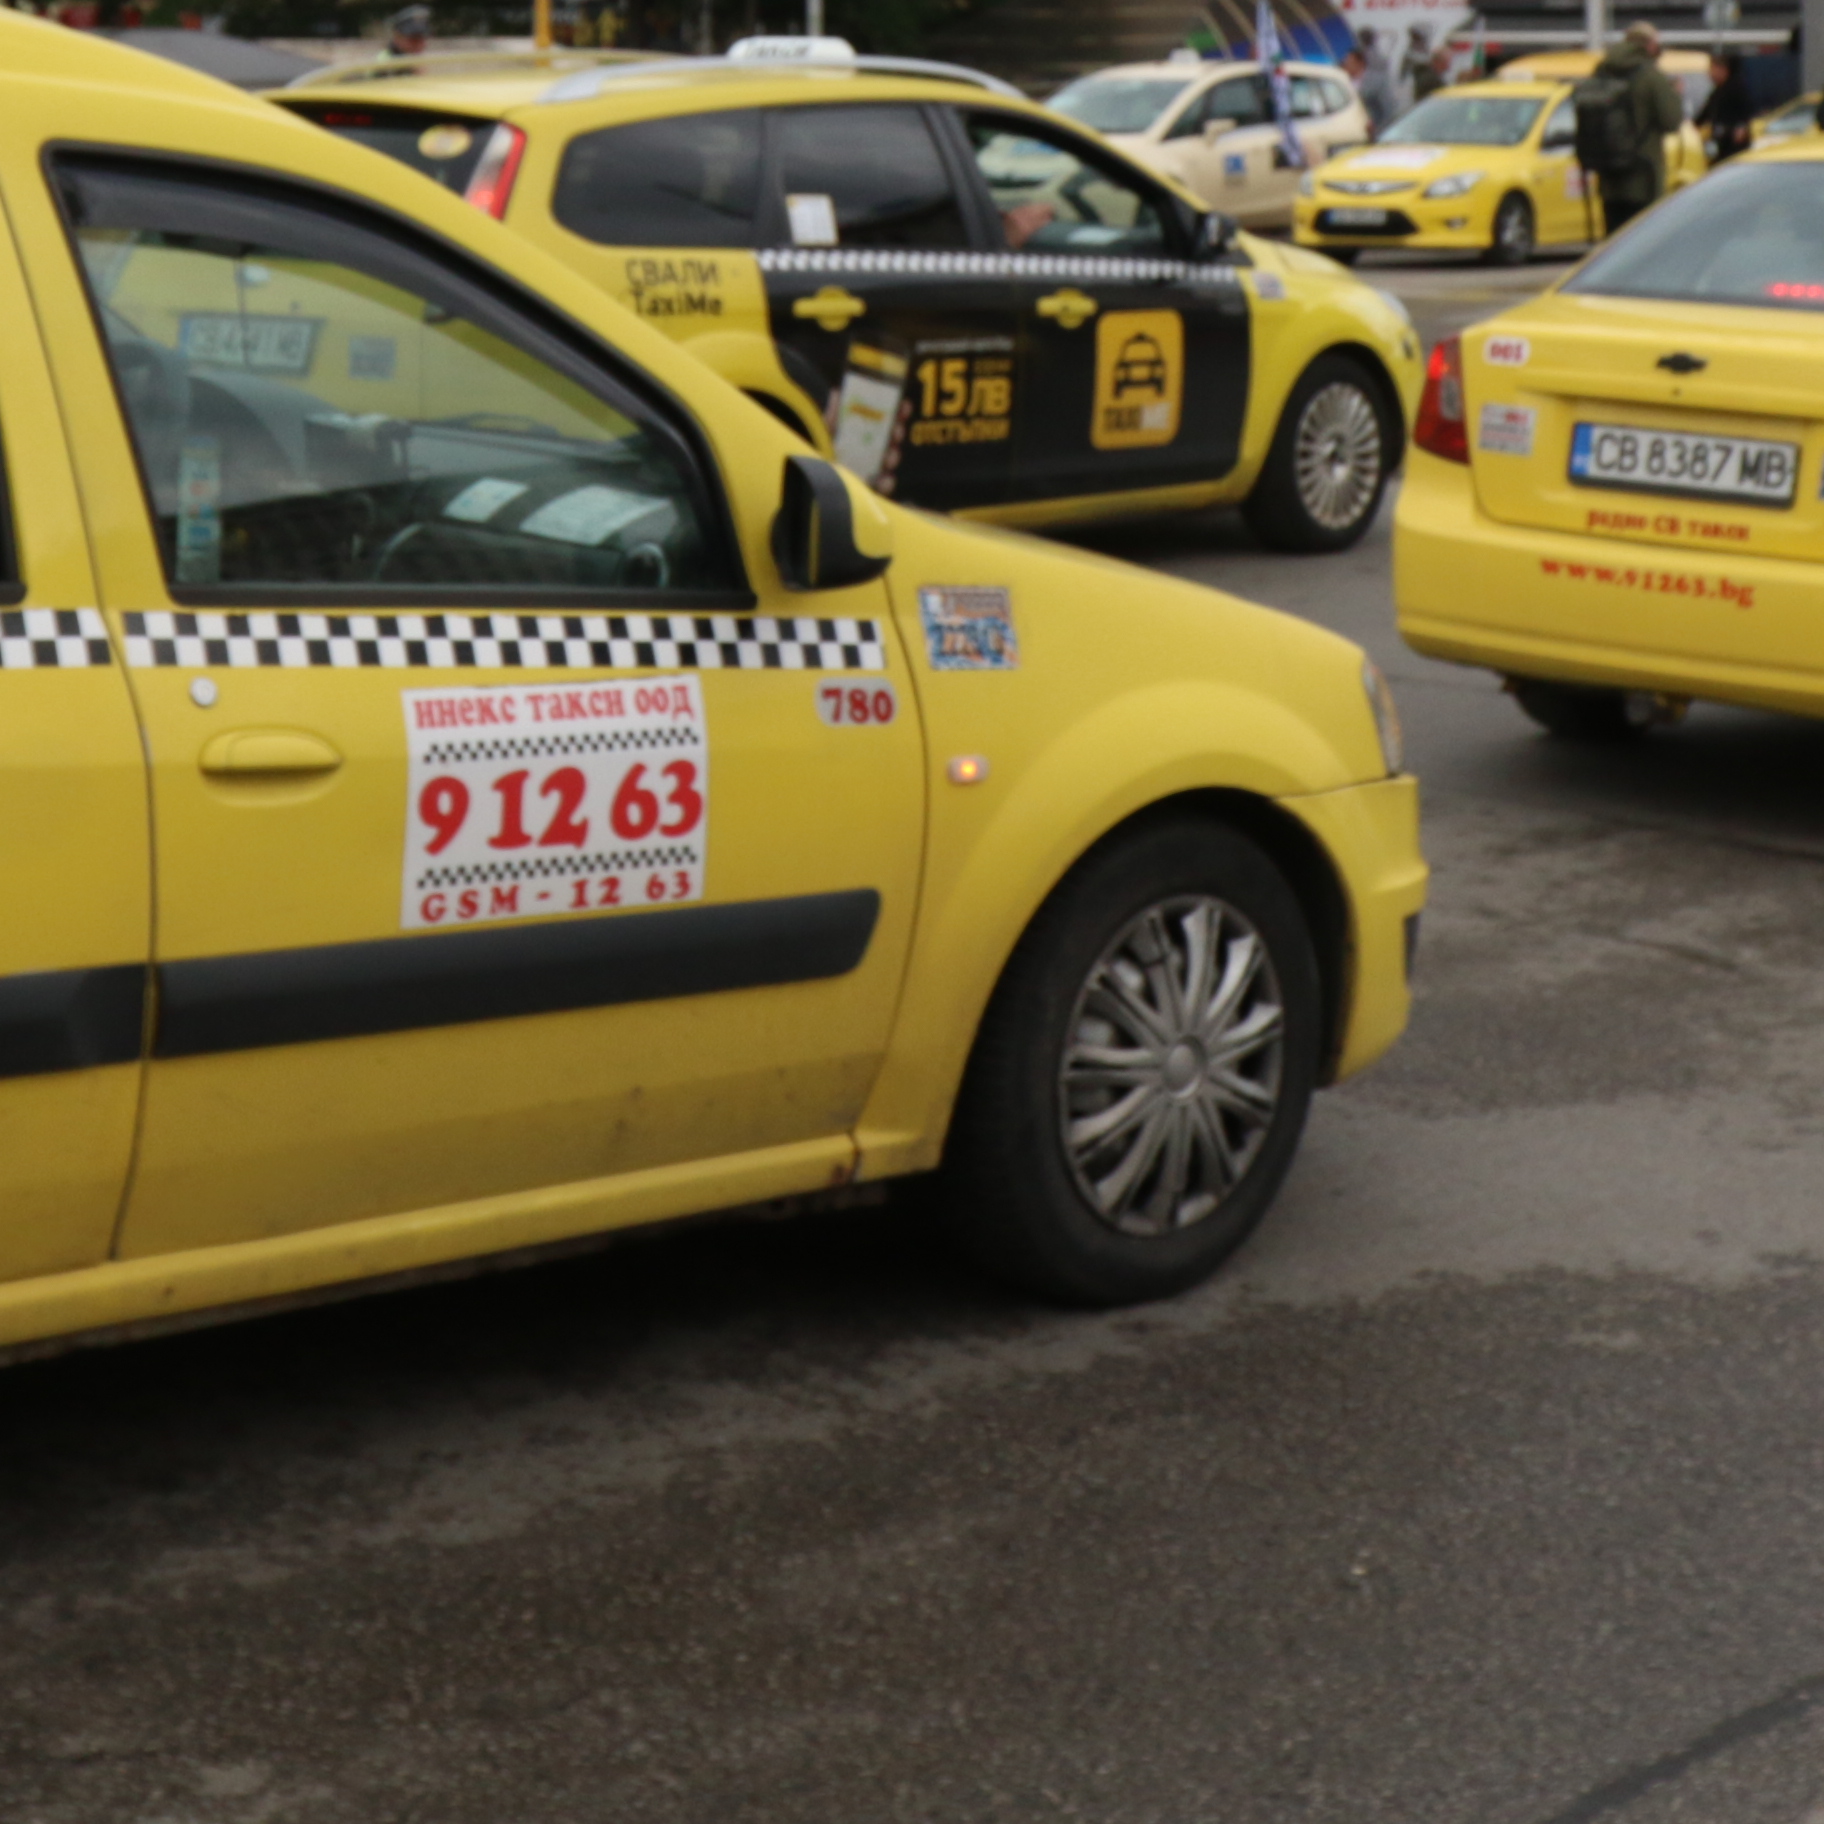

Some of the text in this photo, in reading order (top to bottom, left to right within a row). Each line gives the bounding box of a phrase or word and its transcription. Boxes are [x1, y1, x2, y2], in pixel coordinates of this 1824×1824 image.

[917, 358, 968, 418] 15
[1646, 440, 1734, 485] 8387
[1739, 448, 1789, 490] MB
[822, 686, 895, 725] 780
[419, 884, 520, 923] GSM
